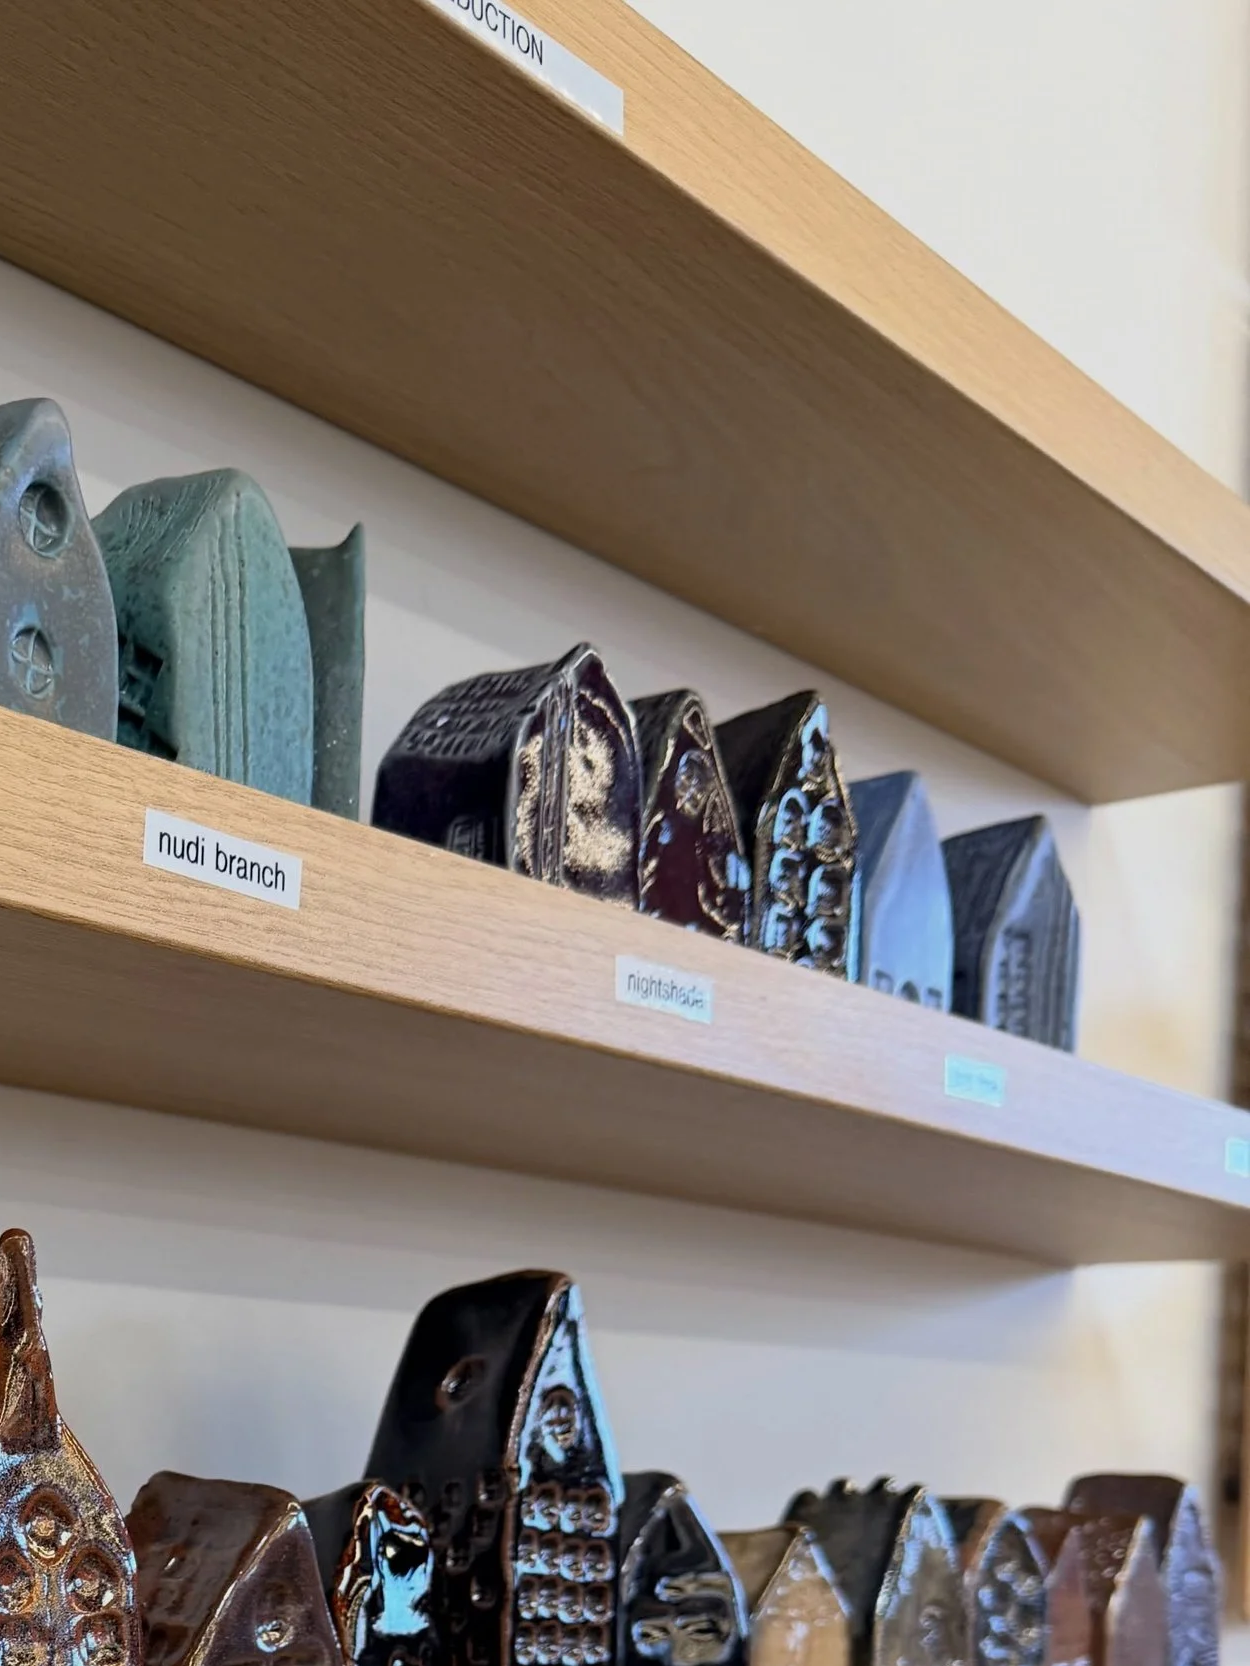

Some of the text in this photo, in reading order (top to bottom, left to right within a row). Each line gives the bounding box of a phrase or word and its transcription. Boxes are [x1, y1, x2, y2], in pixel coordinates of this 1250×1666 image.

[159, 831, 286, 892] nudi branch
[627, 970, 704, 1008] nightshade
